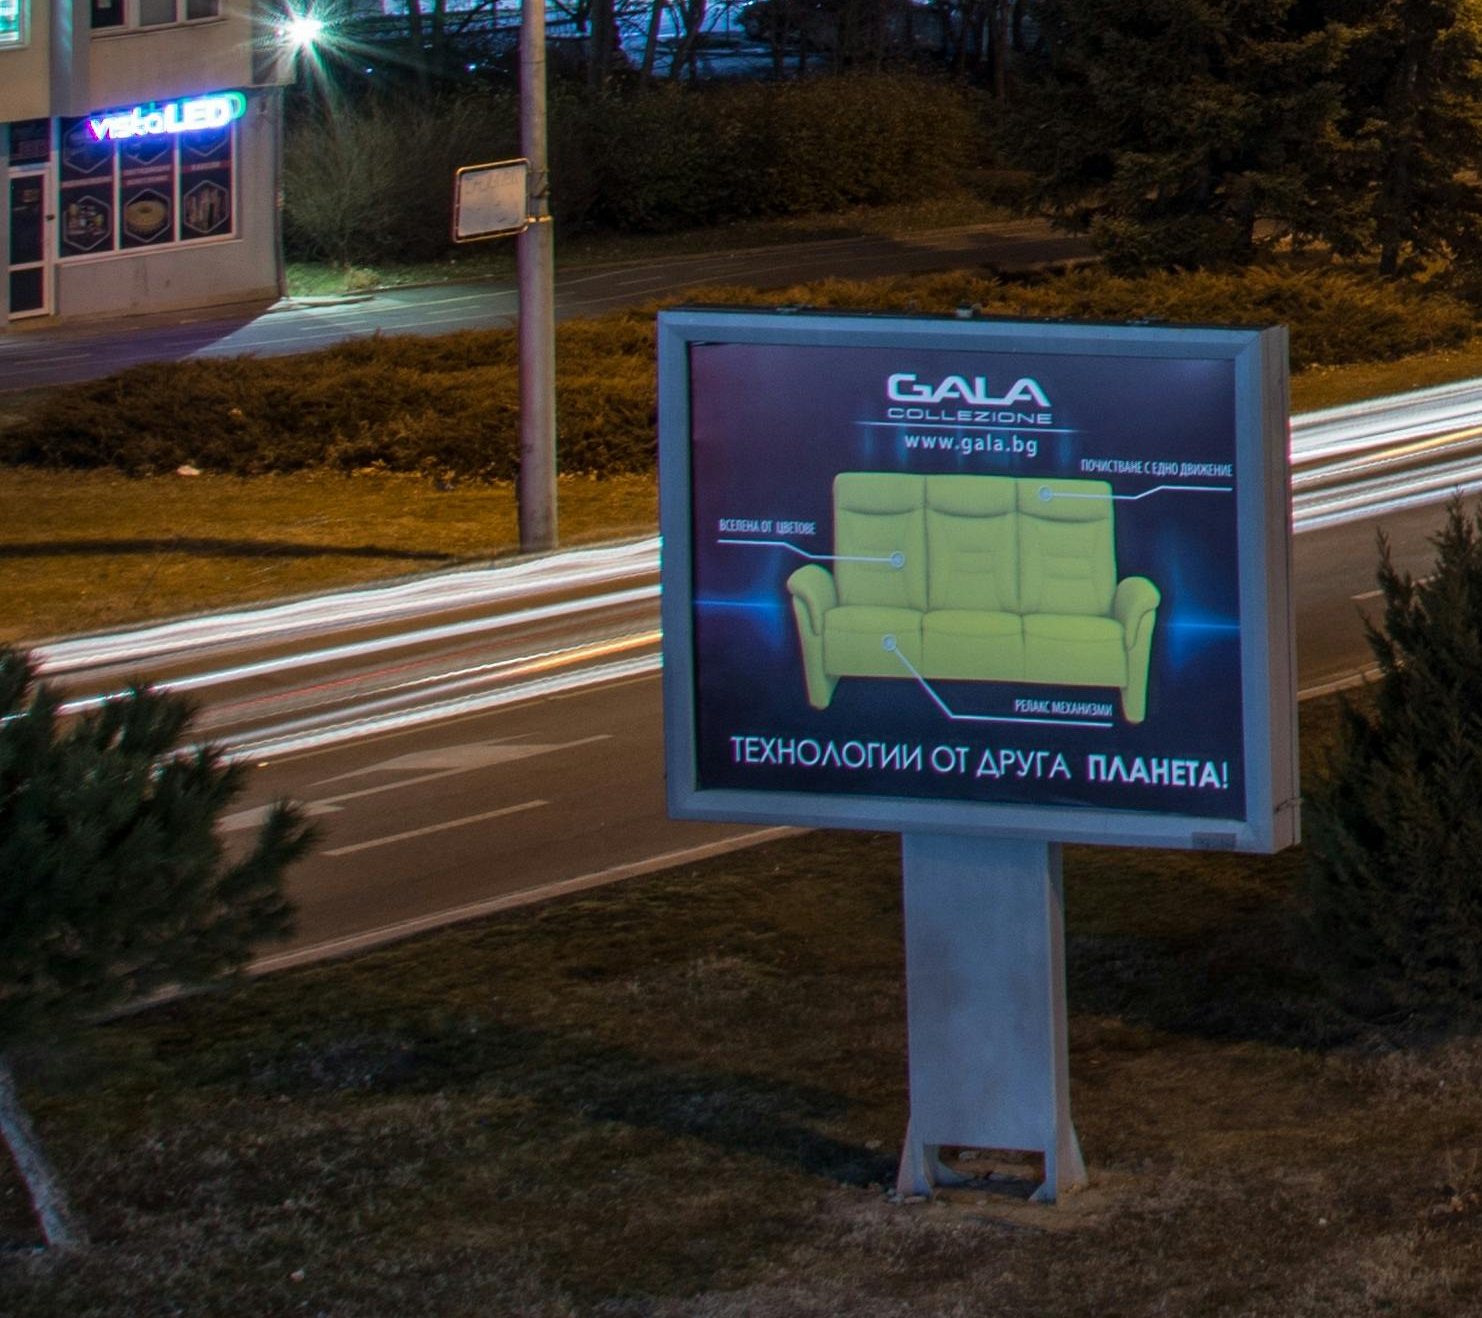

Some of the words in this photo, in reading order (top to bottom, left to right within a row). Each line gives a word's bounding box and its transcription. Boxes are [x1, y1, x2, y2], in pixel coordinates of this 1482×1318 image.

[887, 373, 1052, 407] GALA
[887, 408, 1053, 425] COLLEZIONE
[904, 434, 1039, 457] www.gala.bg
[1081, 459, 1142, 474] ПОЧИСТВАНЕ
[1152, 462, 1178, 476] ЕДНО
[1179, 463, 1233, 477] ДВИЖЕНИЕ
[761, 520, 773, 533] ОТ
[776, 521, 817, 535] ЦВЕТОВЕ
[1015, 699, 1050, 713] РЕЛАКС
[1052, 701, 1113, 716] МЕХАНИЗМИ
[730, 736, 922, 771] ТЕХНОЛОГИИ
[932, 745, 970, 773] ОТ
[976, 748, 1072, 779] ДРУГА
[1088, 754, 1229, 789] ПЛАНЕТА!
